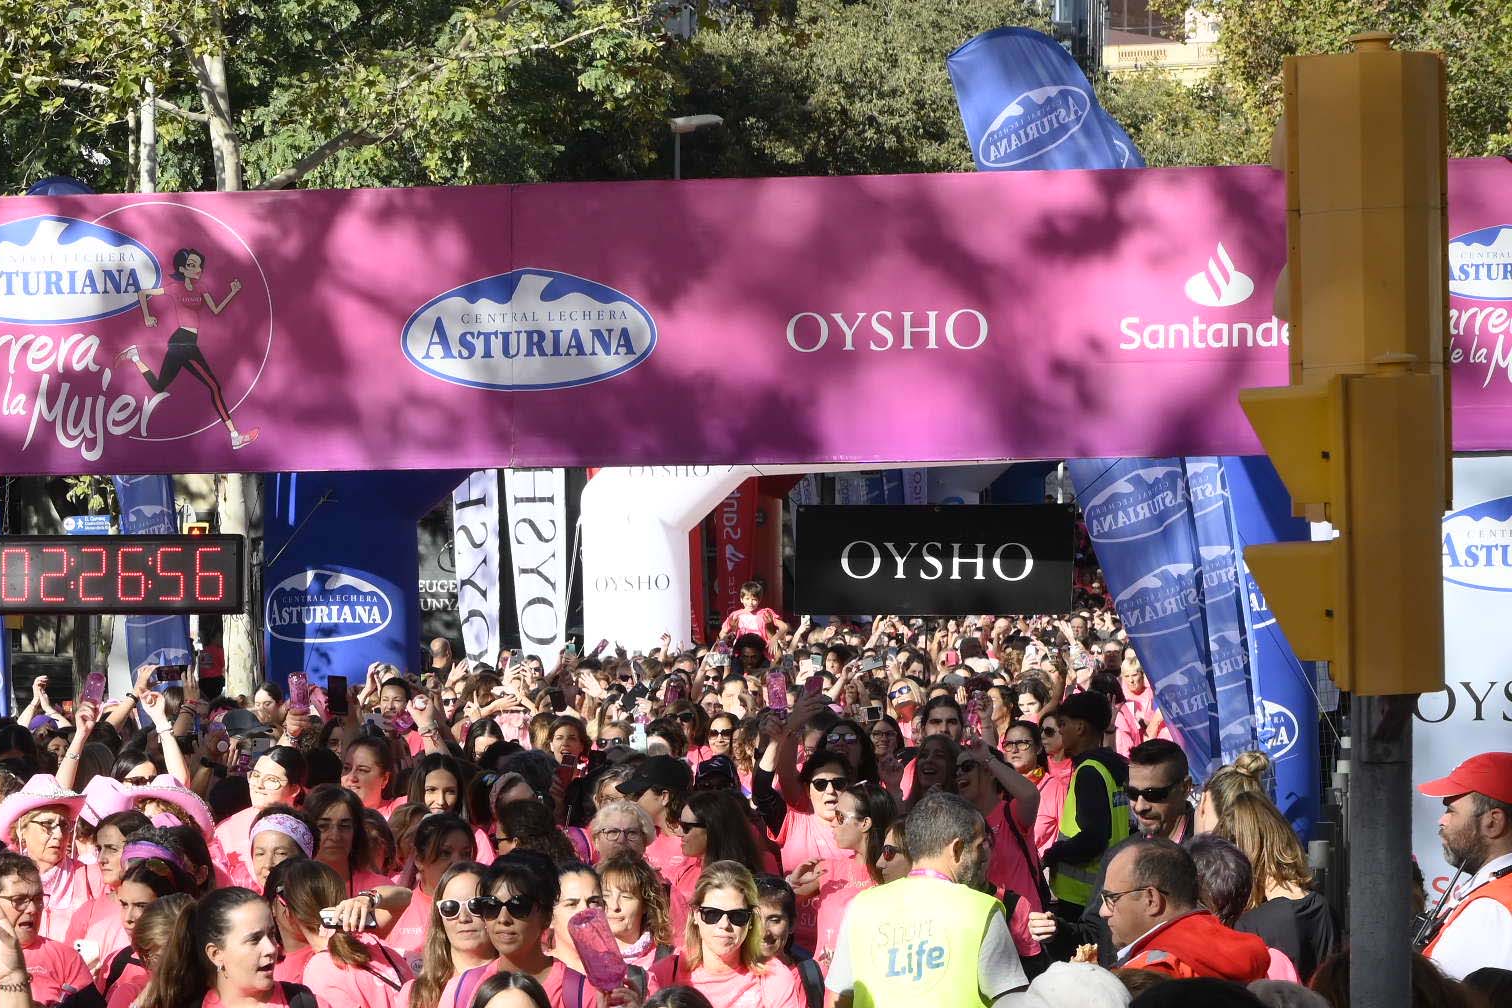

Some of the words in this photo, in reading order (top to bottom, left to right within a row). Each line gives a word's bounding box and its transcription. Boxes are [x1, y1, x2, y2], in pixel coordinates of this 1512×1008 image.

[460, 312, 538, 325] CENTRAL
[547, 309, 629, 323] LECHERA
[786, 308, 988, 354] OYSHO
[1119, 316, 1291, 350] Santande
[423, 315, 637, 360] ASTURIANA
[1470, 336, 1488, 364] la
[2, 377, 27, 415] la
[22, 367, 171, 462] Mujer
[1, 547, 224, 602] 02:26:56
[840, 540, 1034, 582] OYSHO
[282, 594, 325, 603] CENTRAL
[329, 594, 378, 603] LECHERA
[419, 580, 457, 593] EUGE
[271, 600, 382, 626] ASTURIANA
[886, 940, 945, 982] Life
